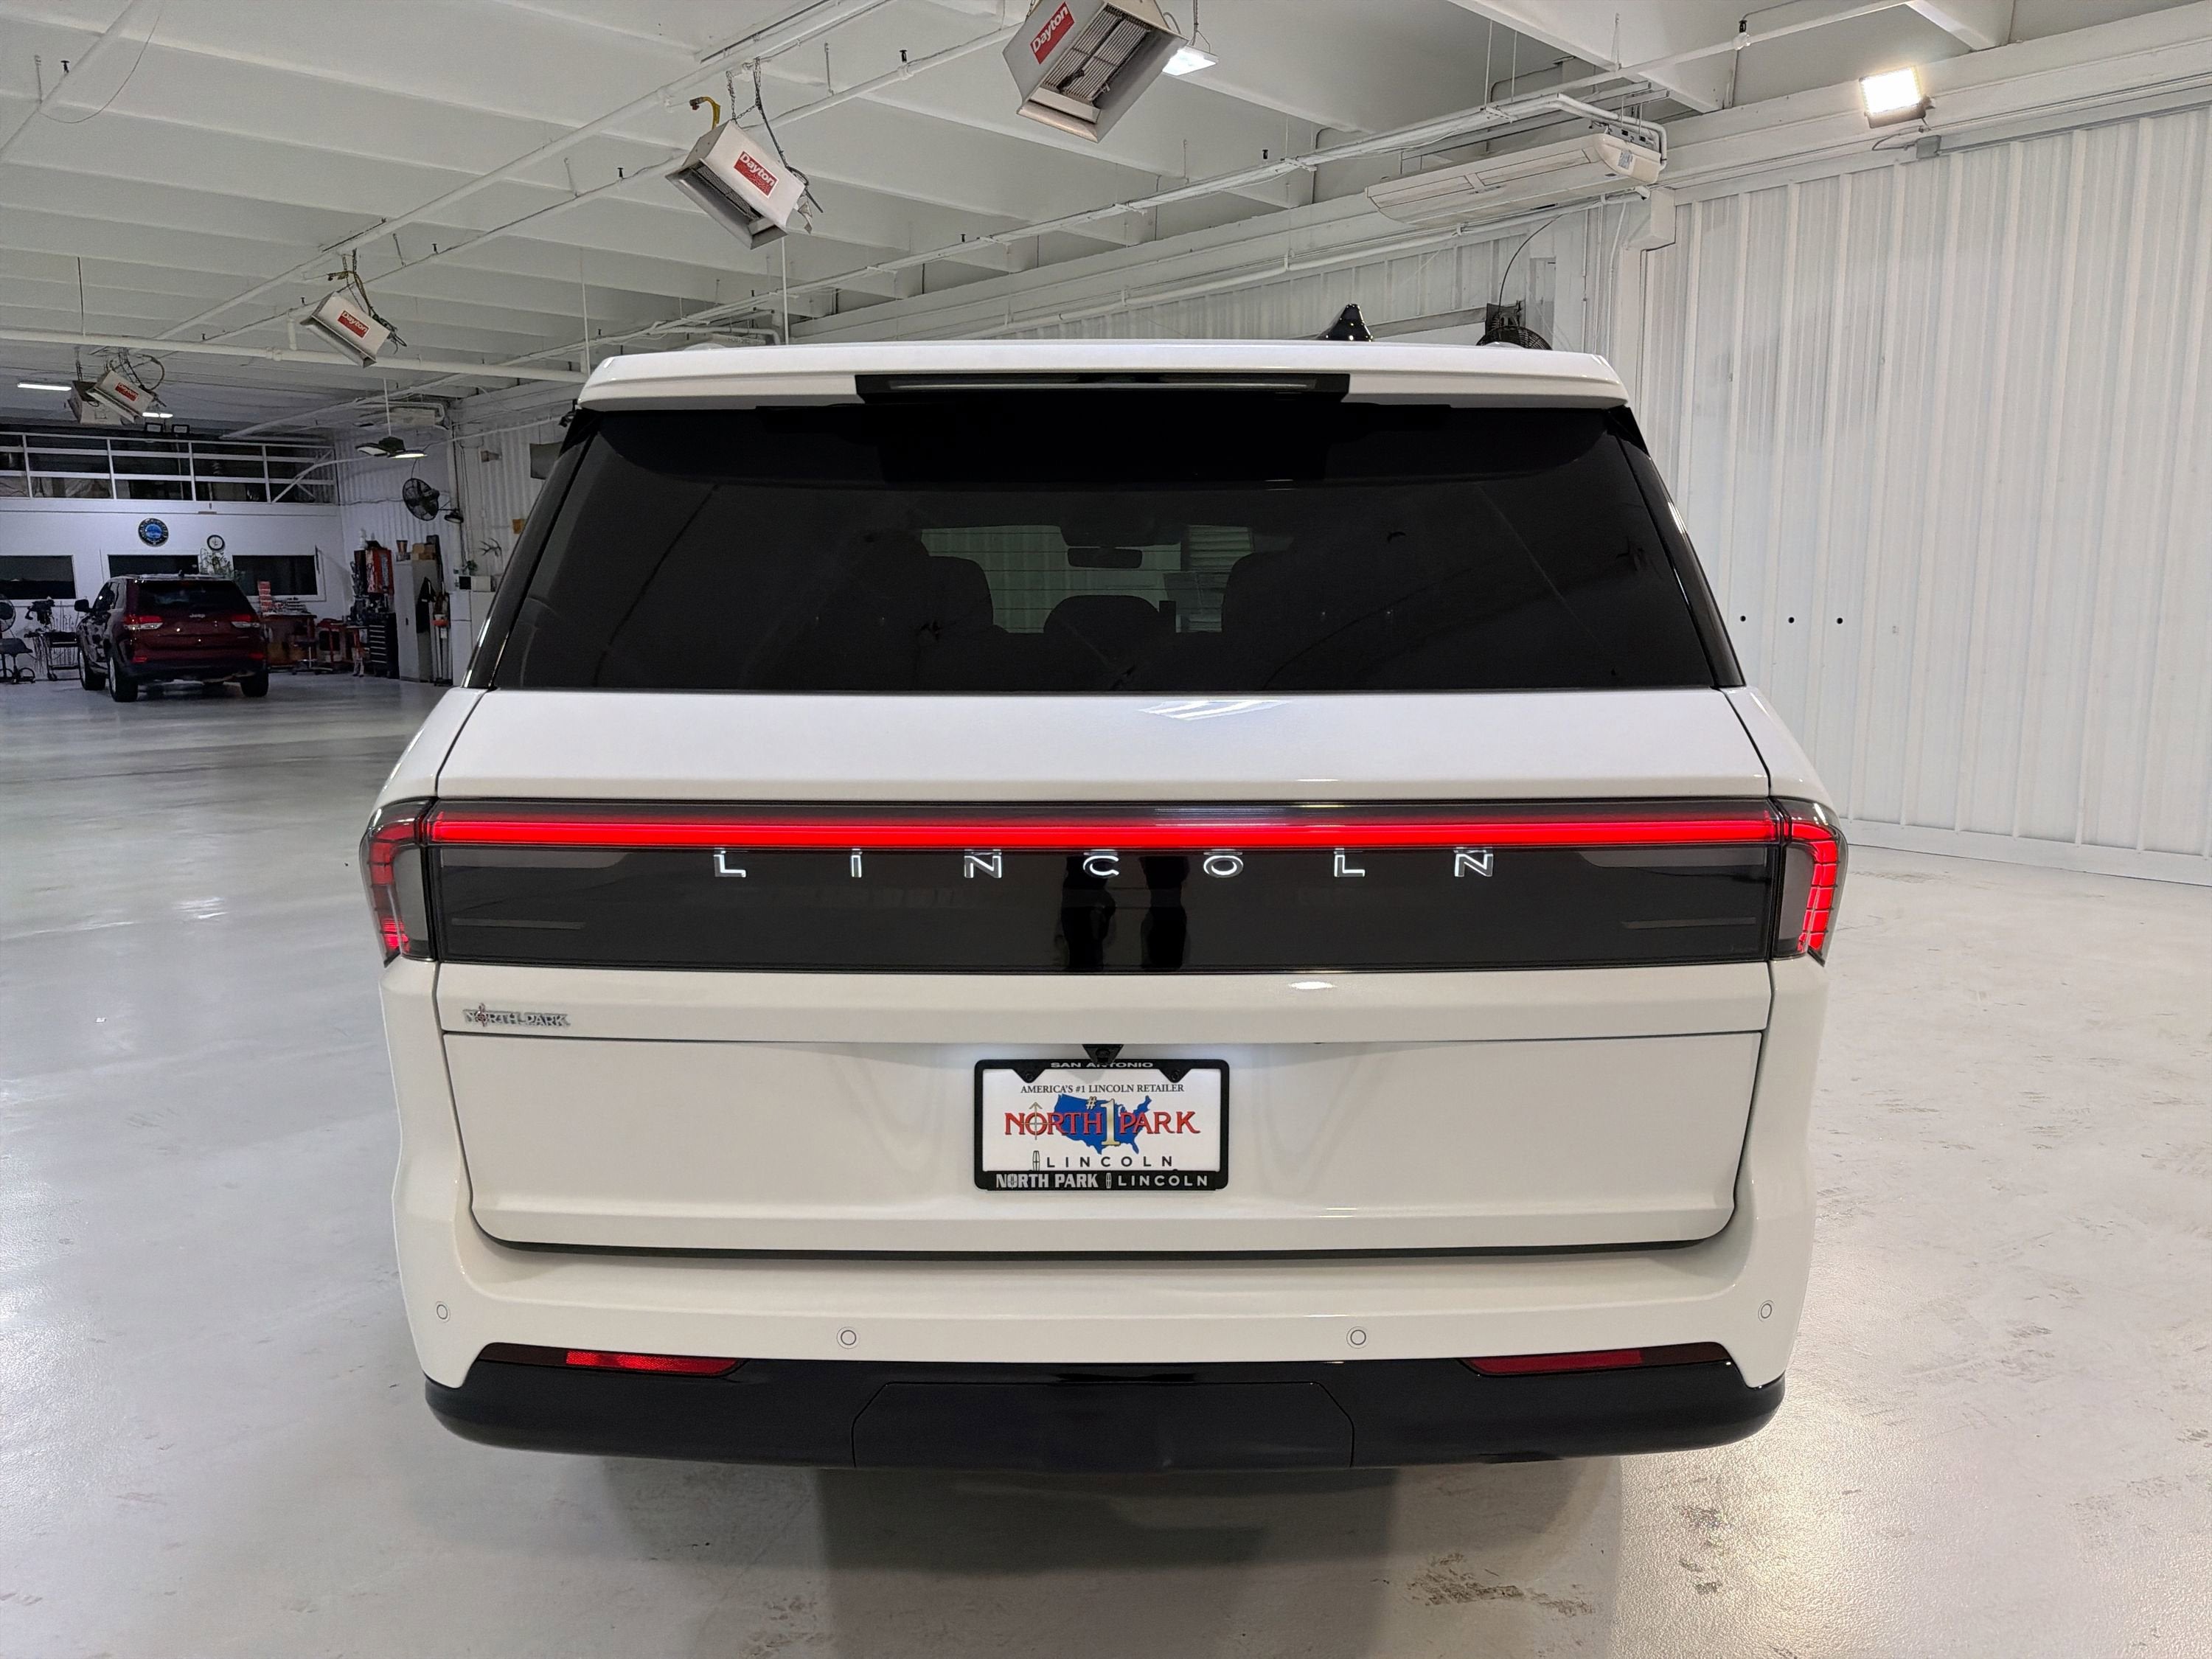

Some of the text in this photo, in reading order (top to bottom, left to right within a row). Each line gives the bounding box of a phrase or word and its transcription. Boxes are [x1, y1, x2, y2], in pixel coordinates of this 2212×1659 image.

[1032, 6, 1068, 53] Dayton
[740, 153, 775, 187] Dayton
[341, 312, 367, 333] Dayton
[713, 854, 1494, 877] LINCOLN
[463, 1007, 571, 1026] NORTH PARK
[1020, 1084, 1184, 1093] AMERICA'S #1 LINCOLN RETAILER
[1004, 1110, 1201, 1136] NORTH PARK
[1046, 1155, 1172, 1168] LINCOLN
[995, 1173, 1208, 1189] NORTH PARK LINCOLN
